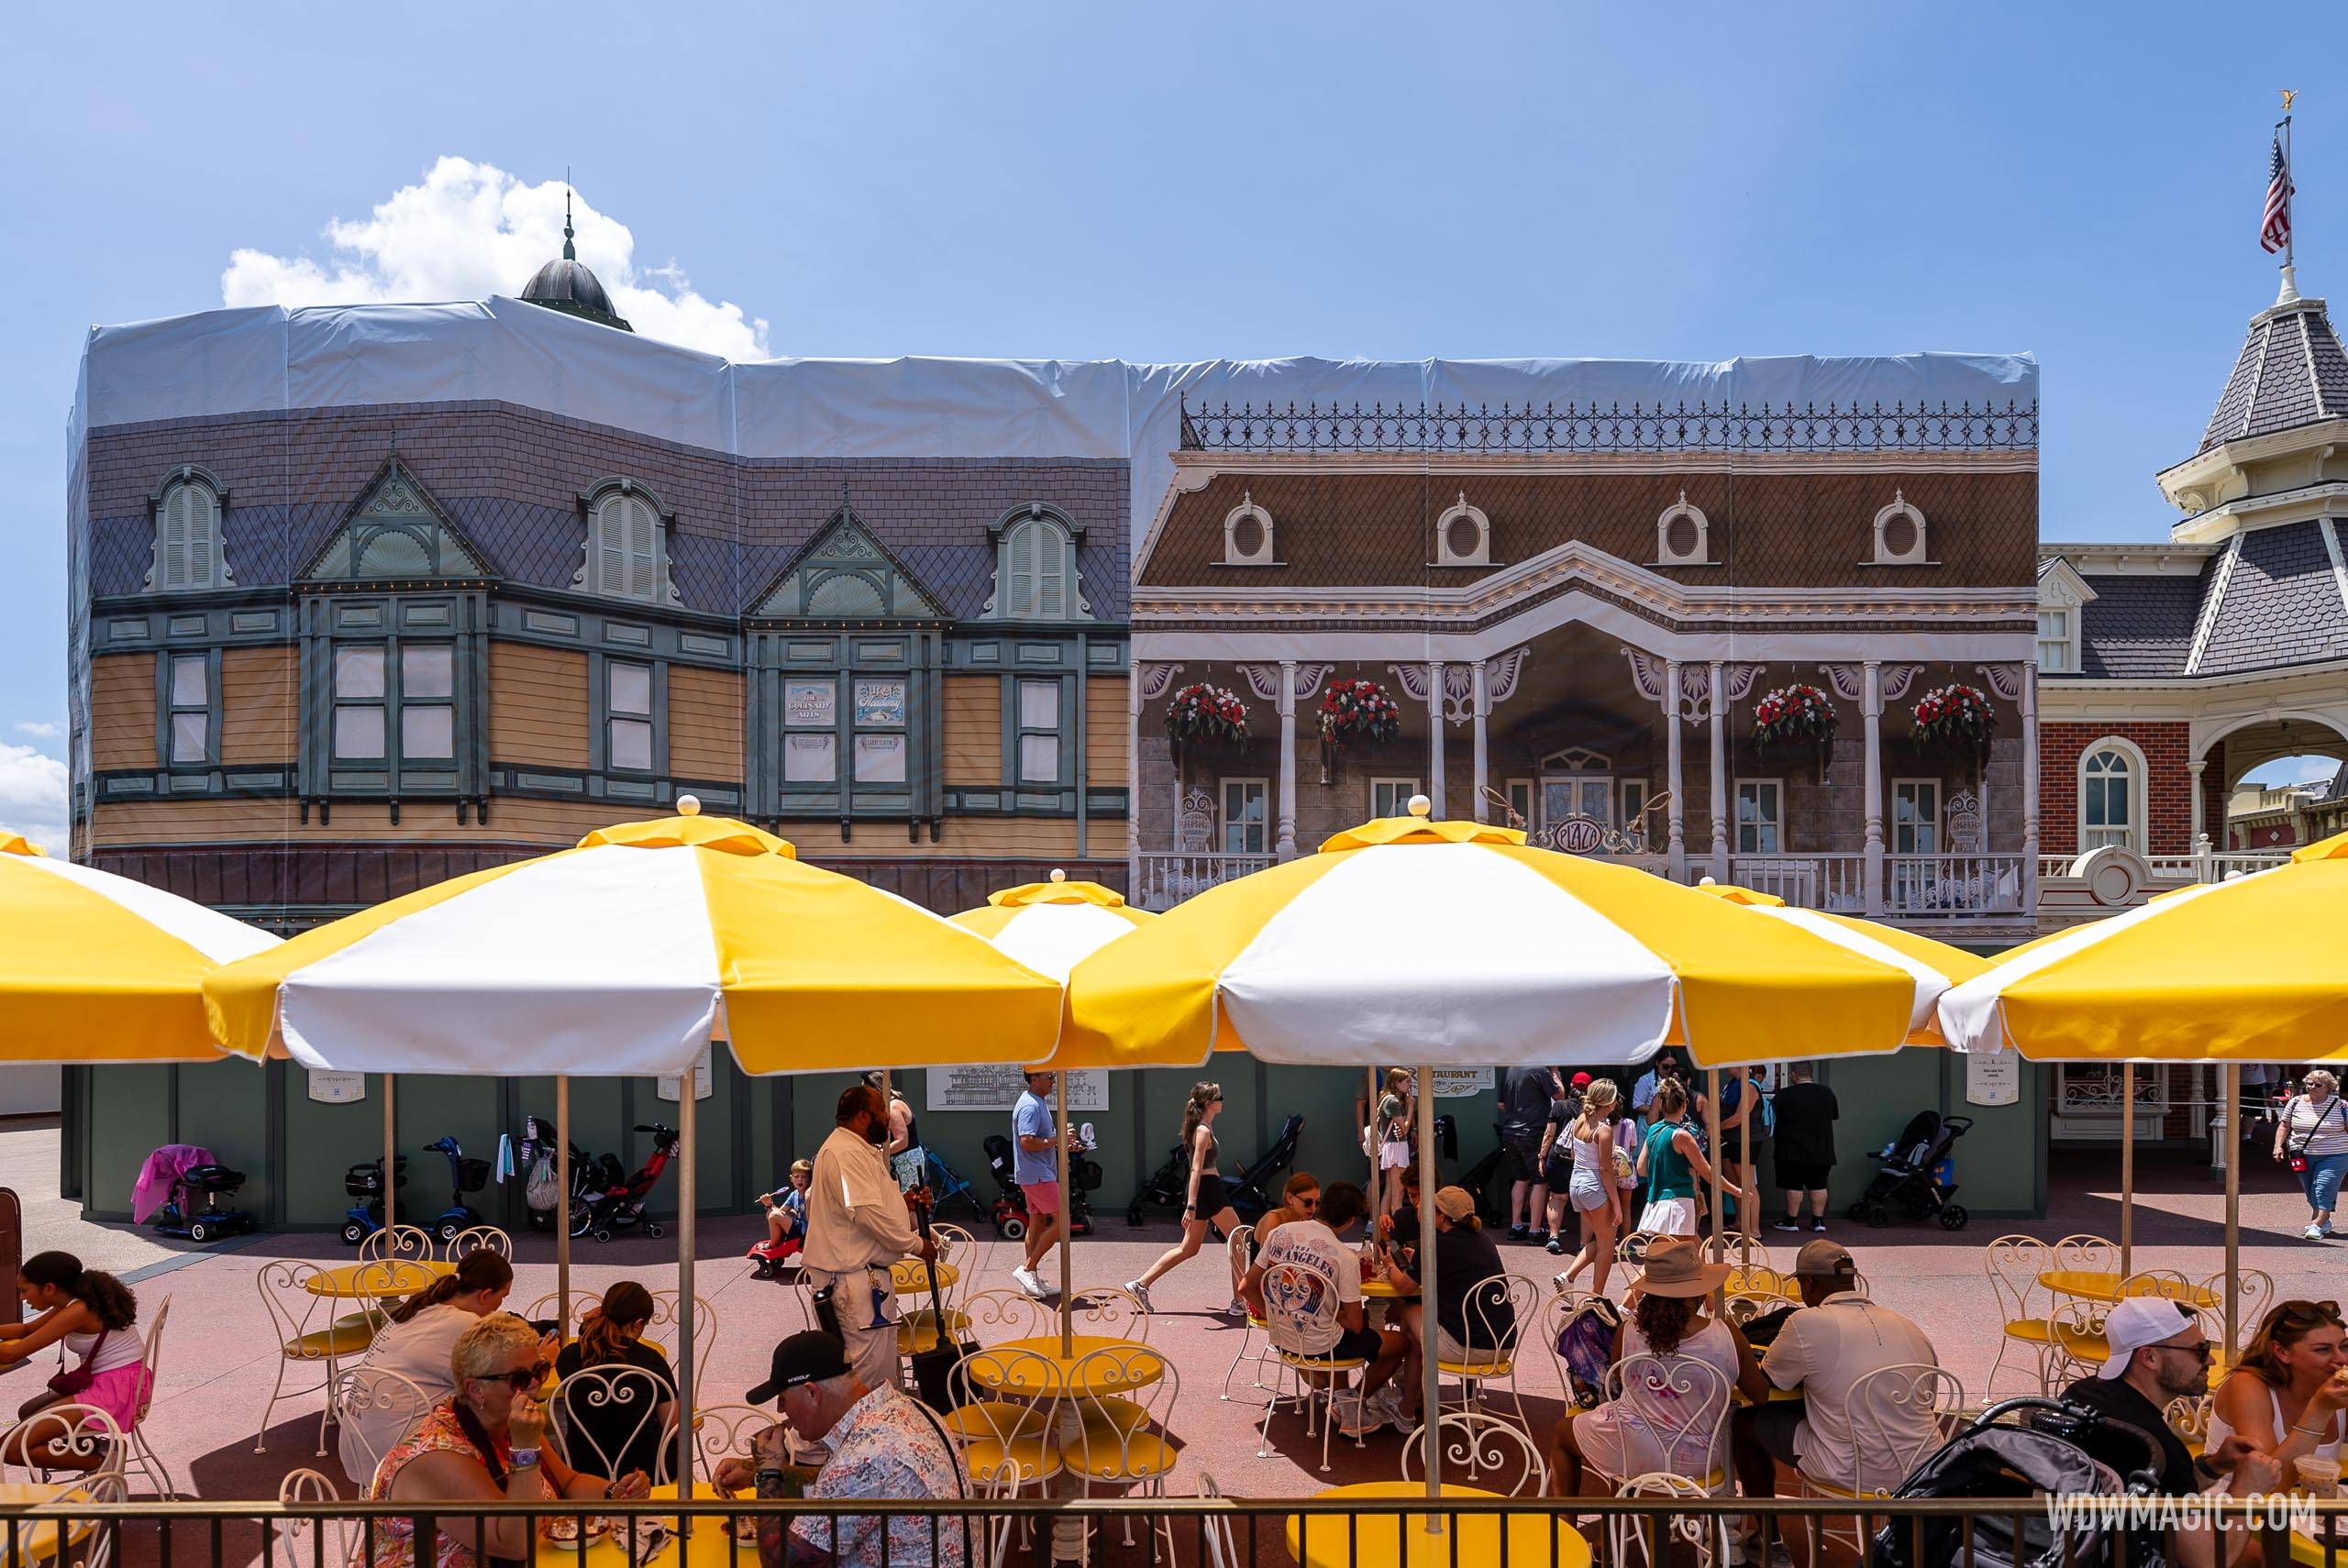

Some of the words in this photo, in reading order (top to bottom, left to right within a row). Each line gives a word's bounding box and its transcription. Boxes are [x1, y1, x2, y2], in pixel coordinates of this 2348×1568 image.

[788, 701, 832, 710] CULINARY
[798, 711, 821, 719] ARTS
[1560, 823, 1597, 850] PLAZA
[1282, 1249, 1335, 1278] ANGELES
